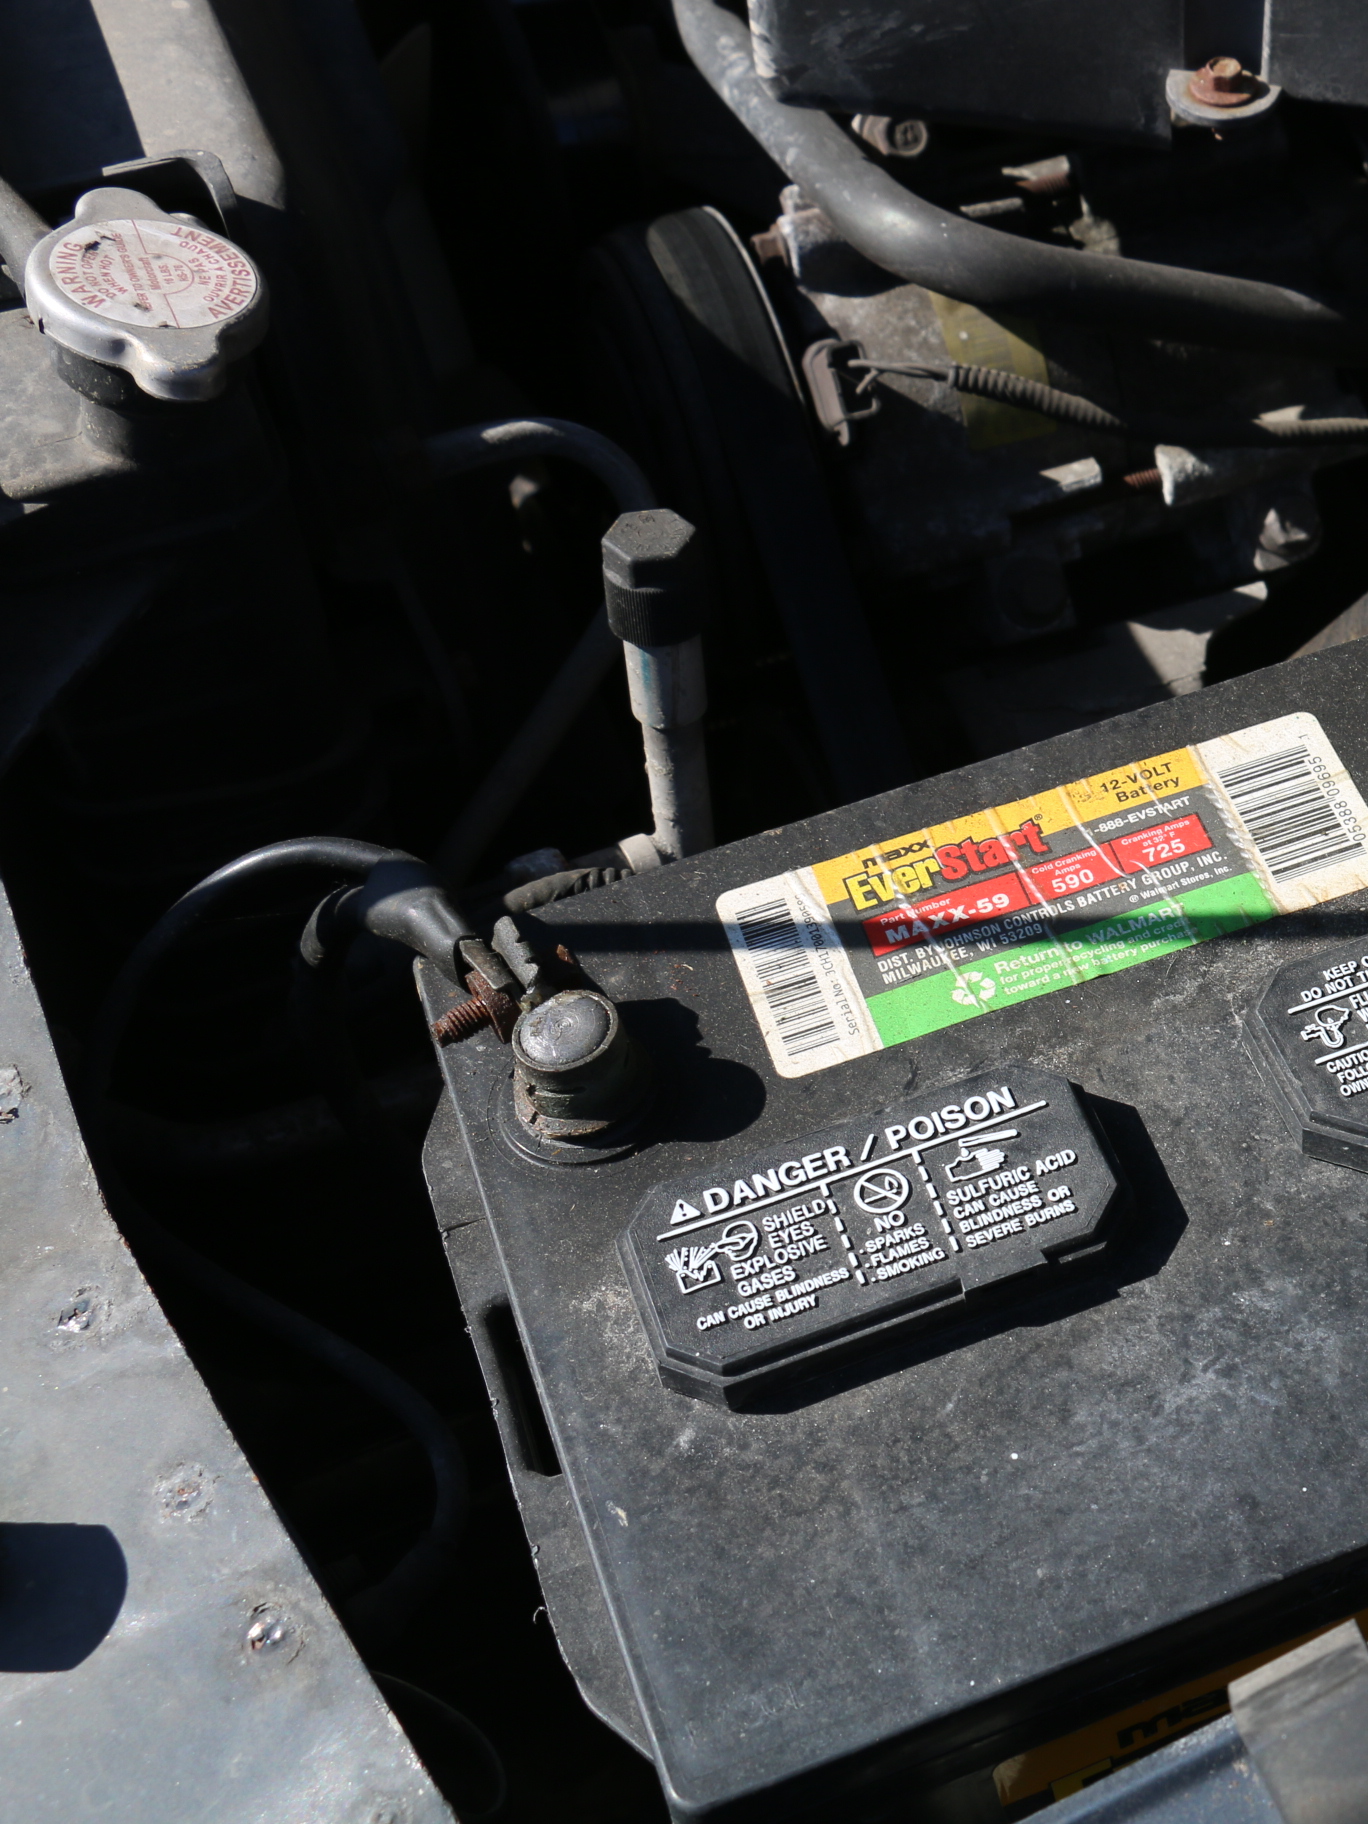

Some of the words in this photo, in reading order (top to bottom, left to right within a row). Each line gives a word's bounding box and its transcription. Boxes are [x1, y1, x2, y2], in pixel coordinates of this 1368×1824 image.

[81, 251, 99, 270] OPEN
[99, 254, 116, 271] HOT
[179, 240, 220, 265] CHAUD
[188, 257, 209, 273] PAS
[56, 242, 107, 309] WARNING
[82, 271, 102, 287] NOT
[100, 272, 129, 294] WHEN
[132, 283, 145, 292] TO
[138, 257, 161, 290] Motorcraft
[170, 226, 252, 319] AVERTISSEMENT
[198, 275, 212, 286] NE
[203, 274, 228, 302] OUVRIR
[98, 287, 118, 299] DO
[1100, 761, 1172, 793] 12-VOLT
[1115, 776, 1180, 803] Battery
[1307, 755, 1341, 798] 09695
[1120, 828, 1163, 846] Cranking
[1163, 820, 1190, 832] Amps
[1333, 799, 1367, 842] 05388
[862, 838, 936, 869] maxx
[1142, 839, 1153, 847] at
[1168, 831, 1177, 839] F
[1142, 838, 1186, 863] 725
[1030, 861, 1054, 875] Cold
[1054, 848, 1097, 870] Cranking
[1054, 863, 1081, 877] Amps
[1051, 868, 1095, 893] 590
[1140, 881, 1181, 900] Walmart
[1181, 871, 1215, 889] Stores,
[1214, 864, 1233, 876] Inc.
[877, 952, 914, 974] DIST.
[916, 943, 934, 960] BY
[939, 923, 1001, 950] JOHNSON
[1002, 900, 1075, 930] CONTROLS
[1076, 876, 1137, 909] BATTERY
[1141, 860, 1195, 886] GROUP,
[1196, 849, 1228, 869] INC.
[880, 912, 906, 926] Part
[905, 897, 951, 918] Number
[885, 892, 1010, 945] MAXX-59
[975, 935, 998, 954] WI
[1000, 923, 1044, 945] 53209
[993, 946, 1061, 974] Return
[1063, 938, 1083, 953] to
[1085, 902, 1184, 946] WALMART
[999, 973, 1022, 986] for
[1022, 960, 1064, 981] proper
[1066, 940, 1126, 964] recycling
[1127, 931, 1151, 944] and
[1004, 975, 1050, 995] toward
[1052, 971, 1062, 981] a
[1091, 949, 1138, 969] battery
[1140, 927, 1199, 953] purchase
[1322, 959, 1358, 981] KEEP
[829, 978, 845, 1001] No:
[1300, 986, 1323, 1003] DO
[1324, 975, 1356, 995] NOT
[835, 999, 860, 1036] Serial
[702, 1145, 851, 1214] DANGER
[884, 1086, 1016, 1150] POISON
[946, 1165, 1031, 1207] SULFURIC
[1035, 1149, 1077, 1176] ACID
[953, 1200, 986, 1219] CAN
[988, 1180, 1040, 1207] CAUSE
[958, 1194, 1043, 1234] BLINDNESS
[1047, 1185, 1072, 1202] OR
[762, 1199, 826, 1232] SHIELD
[873, 1210, 905, 1233] NO
[965, 1218, 1023, 1249] SEVERE
[1024, 1199, 1076, 1227] BURNS
[768, 1220, 815, 1249] EYES
[730, 1234, 828, 1280] EXPLOSIVE
[737, 1265, 797, 1297] GASES
[696, 1310, 726, 1331] CAN
[727, 1293, 773, 1319] CAUSE
[775, 1267, 850, 1304] BLINDNESS
[743, 1313, 766, 1330] OR
[768, 1294, 817, 1321] INJURY
